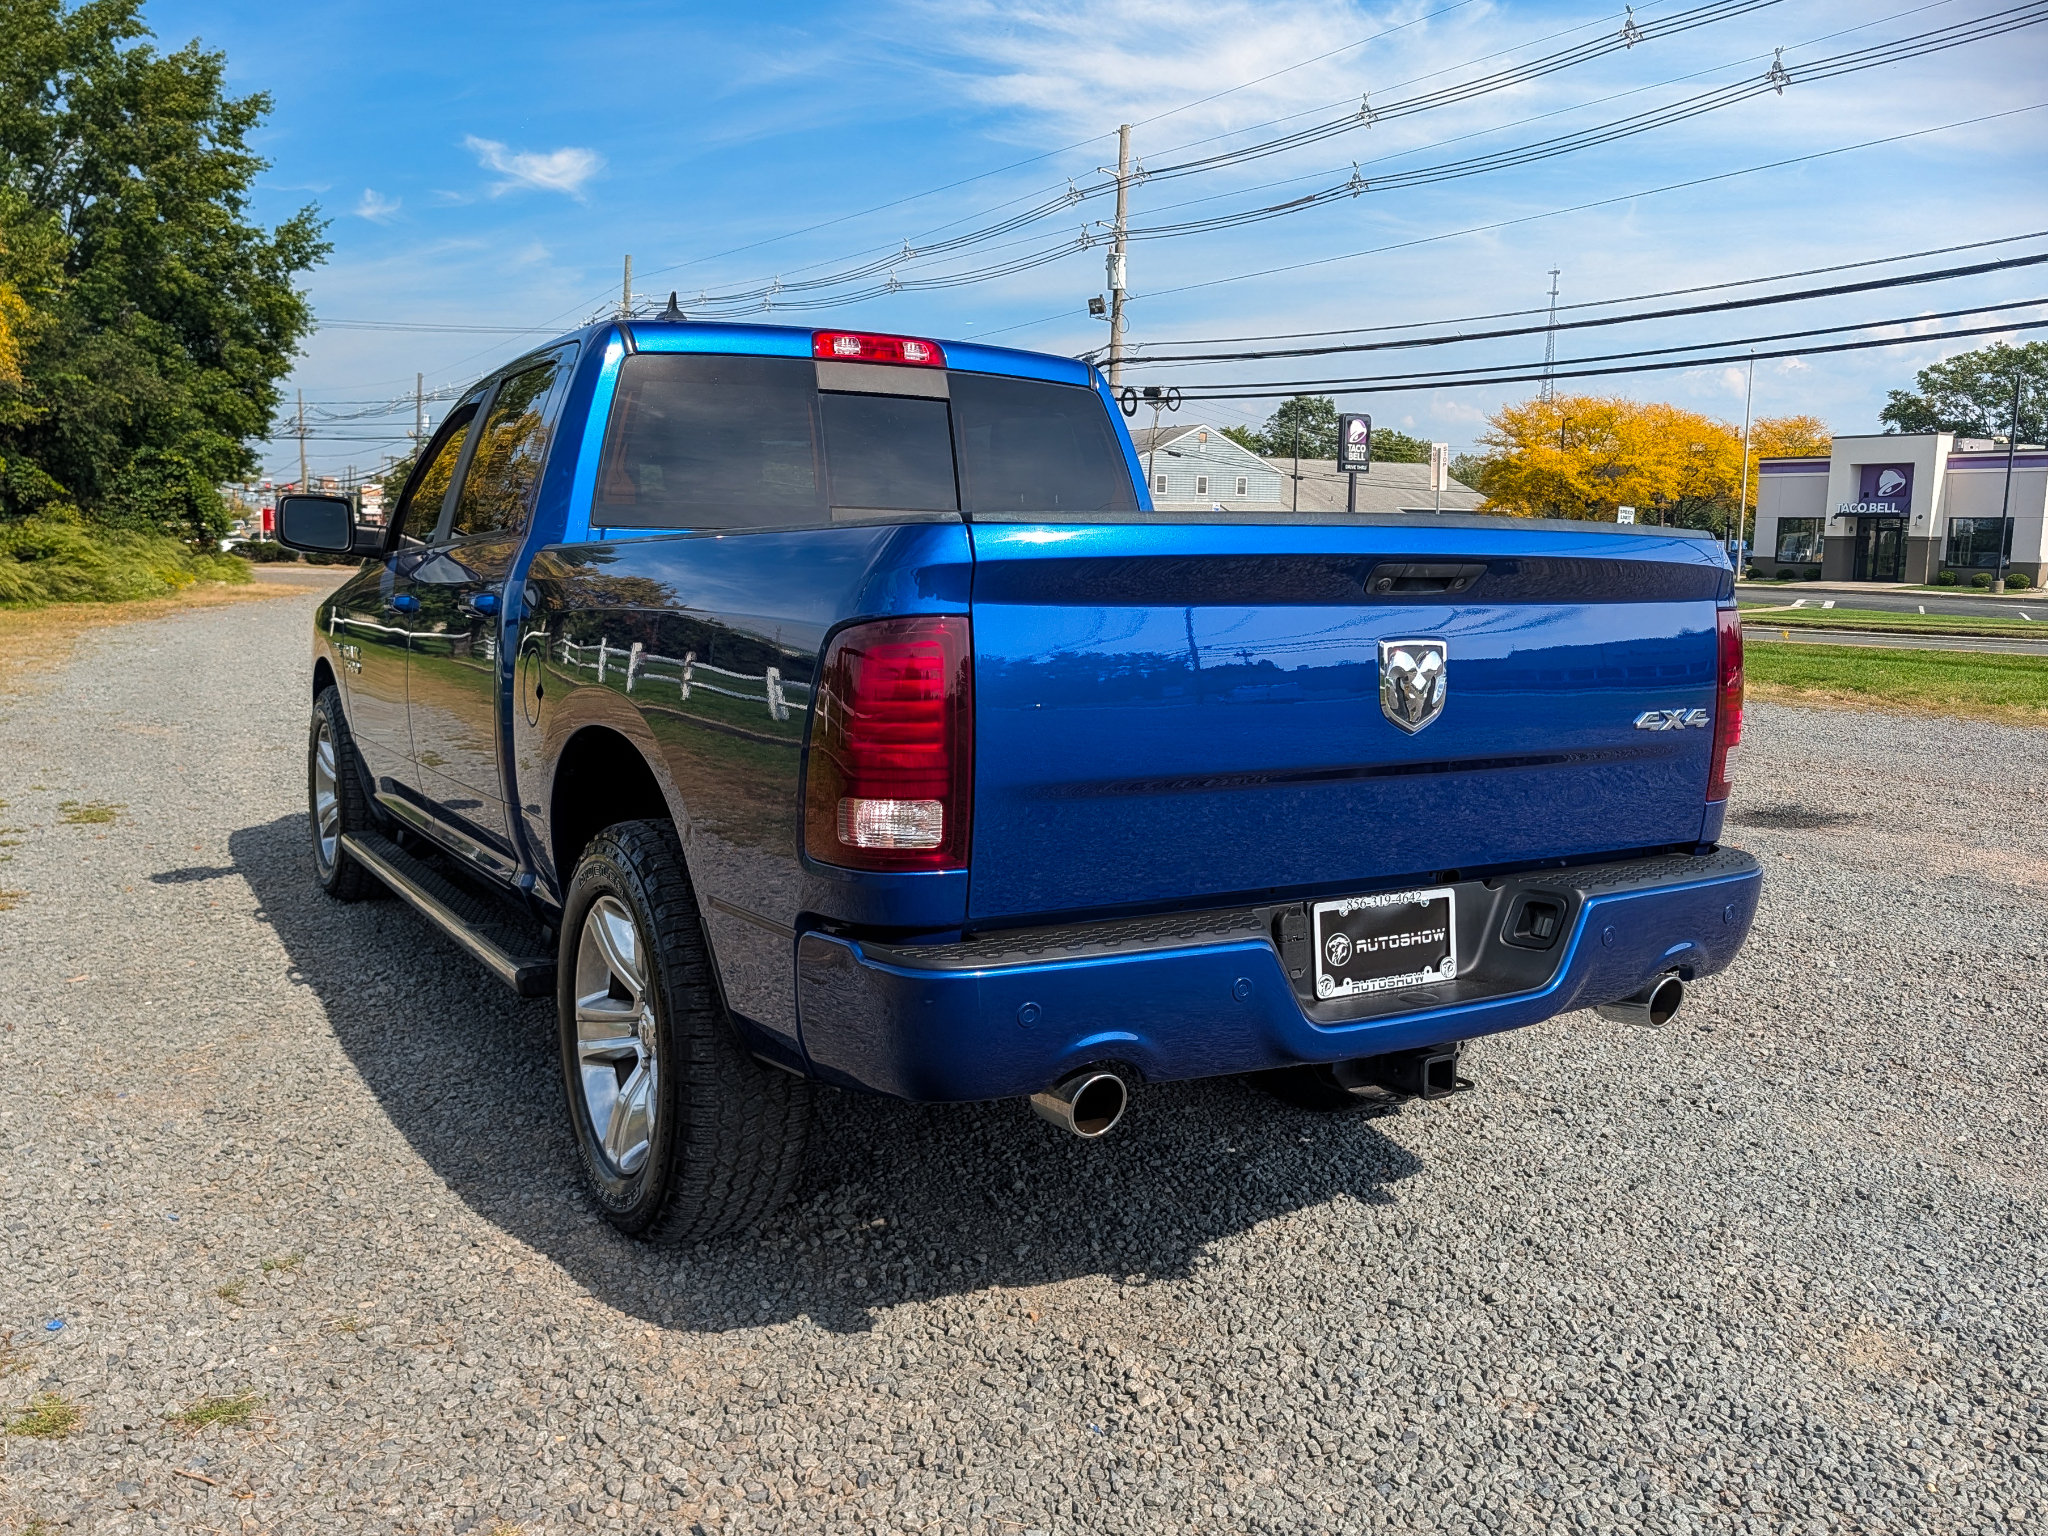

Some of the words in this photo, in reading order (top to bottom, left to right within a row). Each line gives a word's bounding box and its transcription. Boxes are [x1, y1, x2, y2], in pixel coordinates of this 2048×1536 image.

[1348, 444, 1366, 452] TACO
[1348, 452, 1366, 460] BELL
[1836, 502, 1867, 513] TACO
[1869, 502, 1898, 513] BELL
[1346, 891, 1422, 910] 856-319-4642
[1355, 927, 1446, 954] AUTOSHOW
[1351, 972, 1425, 994] AUTOSHOW
